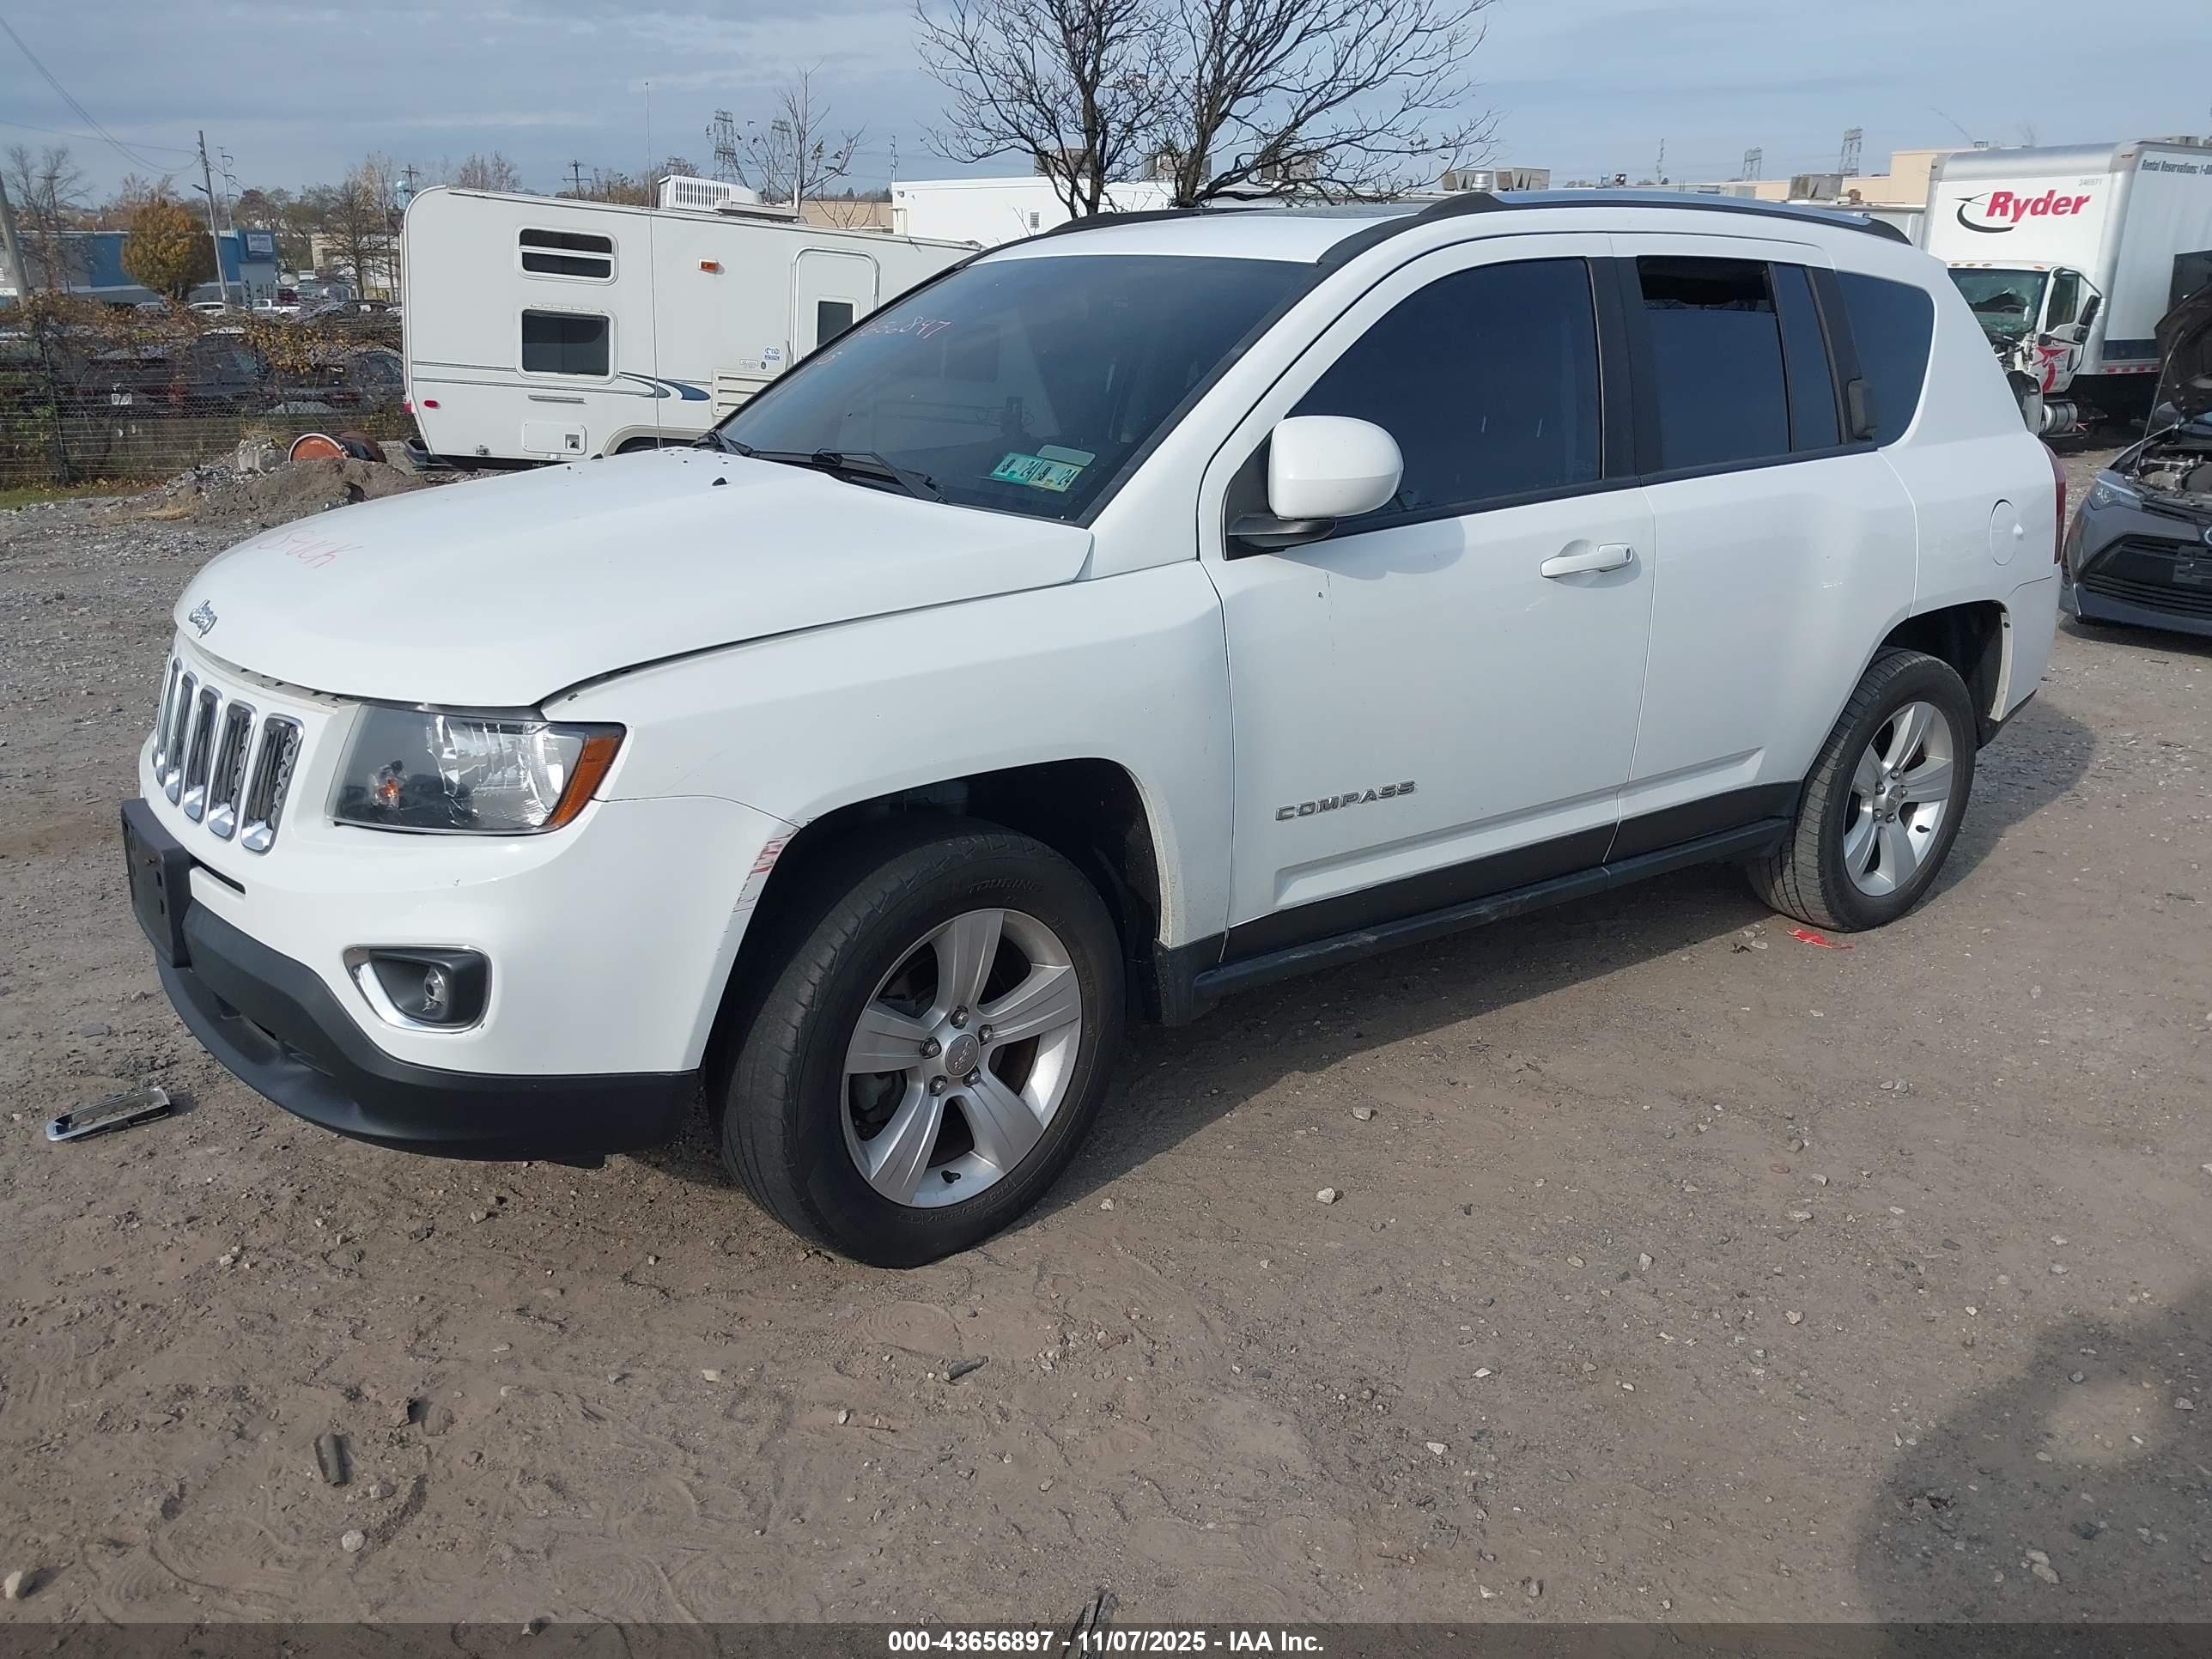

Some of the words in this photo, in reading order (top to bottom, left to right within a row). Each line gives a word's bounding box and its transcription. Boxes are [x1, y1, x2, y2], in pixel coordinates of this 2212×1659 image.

[1985, 189, 2092, 223] Ryder
[1019, 460, 1040, 478] 24
[1057, 468, 1078, 488] 24
[1275, 780, 1415, 821] COMPASS
